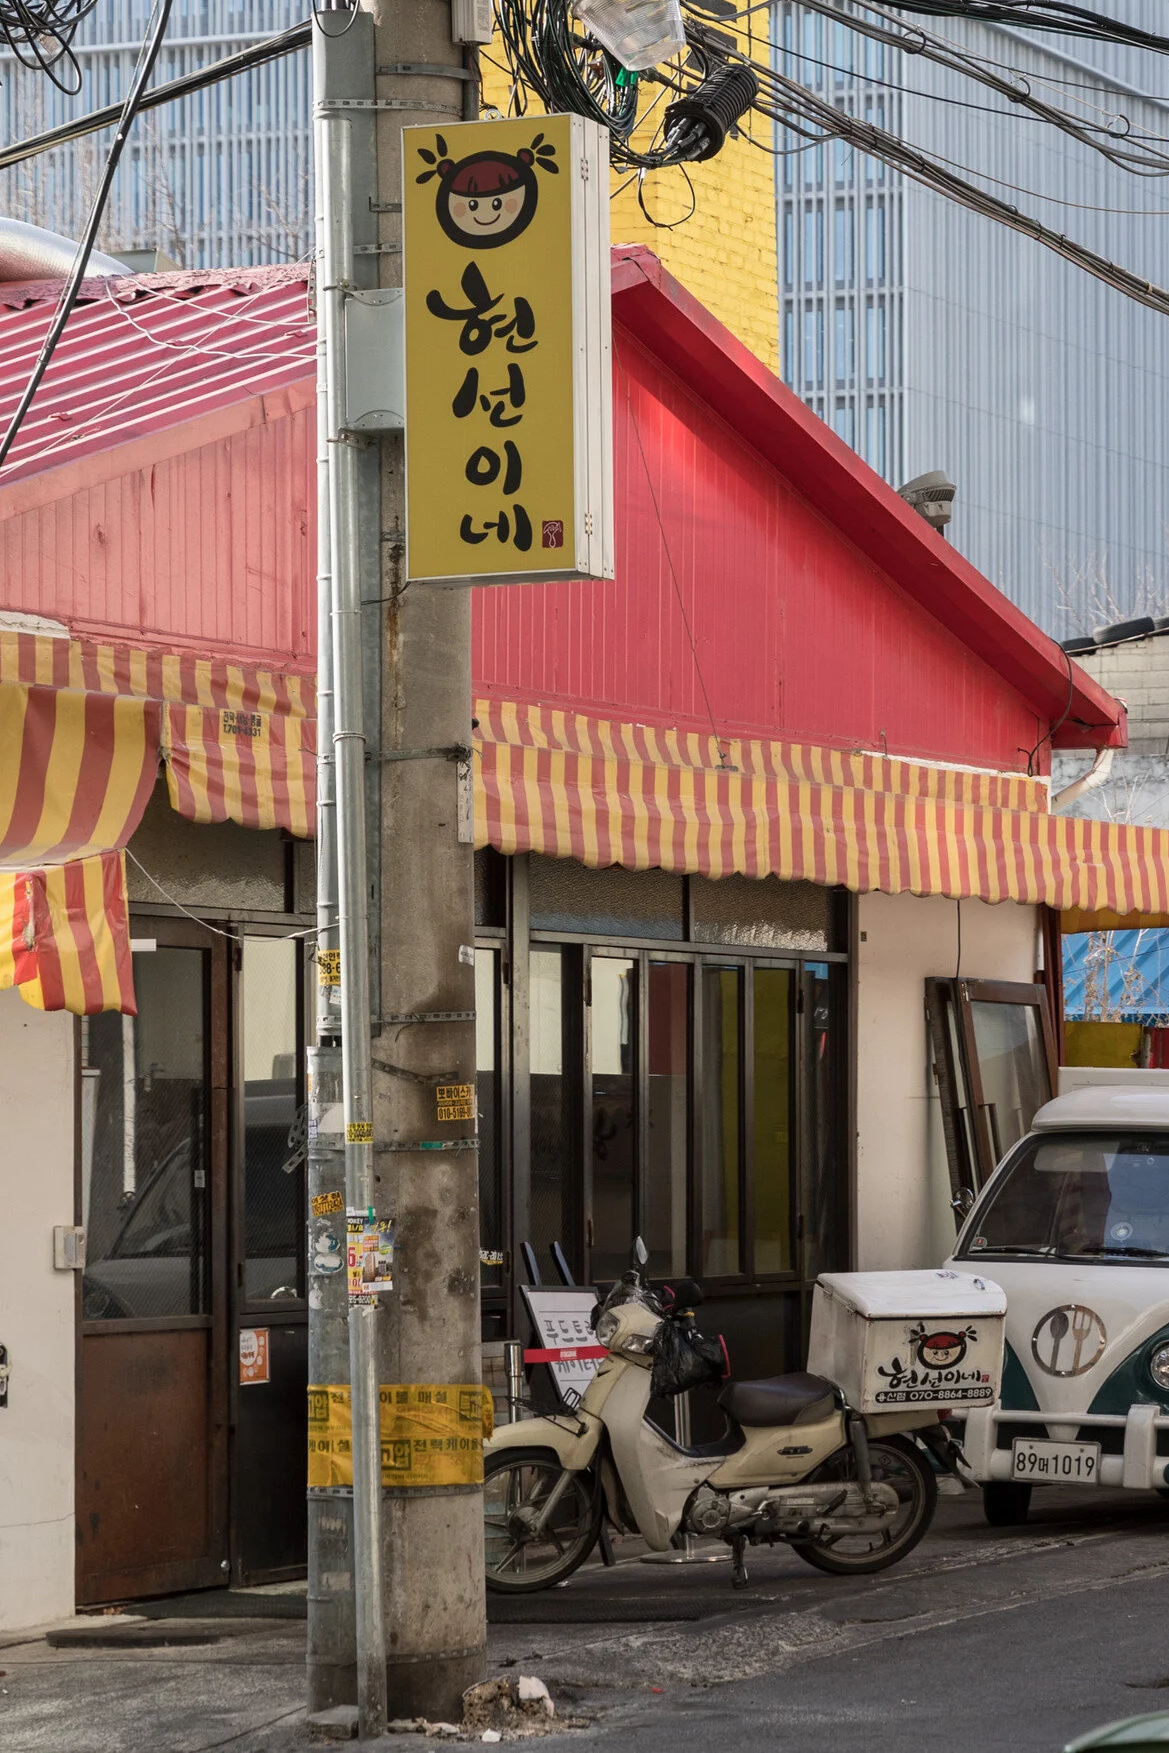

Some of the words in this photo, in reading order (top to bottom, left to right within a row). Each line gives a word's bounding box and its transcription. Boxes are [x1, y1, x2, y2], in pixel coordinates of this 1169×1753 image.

[426, 260, 539, 552] 현선이네
[877, 1357, 981, 1388] 현선이네
[909, 1388, 992, 1400] 070-8864-8889
[1016, 1452, 1095, 1476] 89머1019
